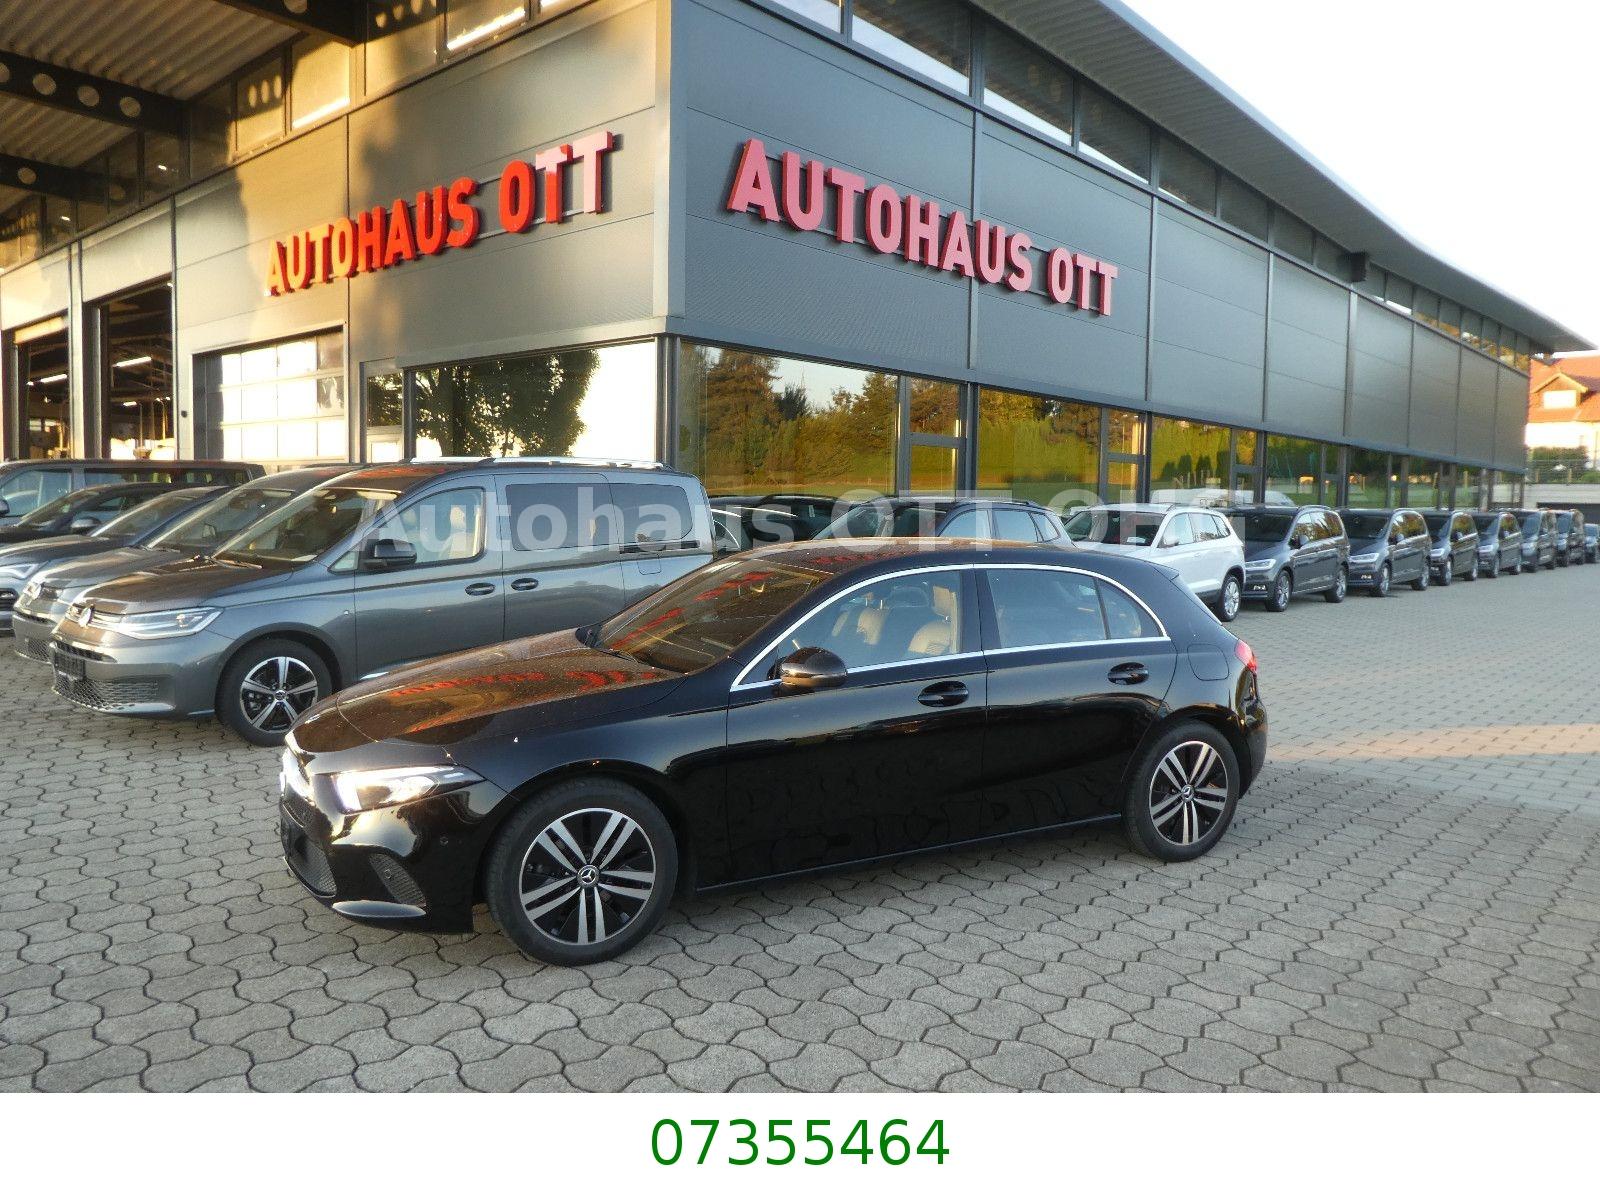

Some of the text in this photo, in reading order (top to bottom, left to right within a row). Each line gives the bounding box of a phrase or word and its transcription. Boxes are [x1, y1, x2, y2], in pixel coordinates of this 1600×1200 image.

[264, 131, 615, 297] AUTOHAUS OTT
[727, 137, 1119, 317] AUTOHAUS OTT
